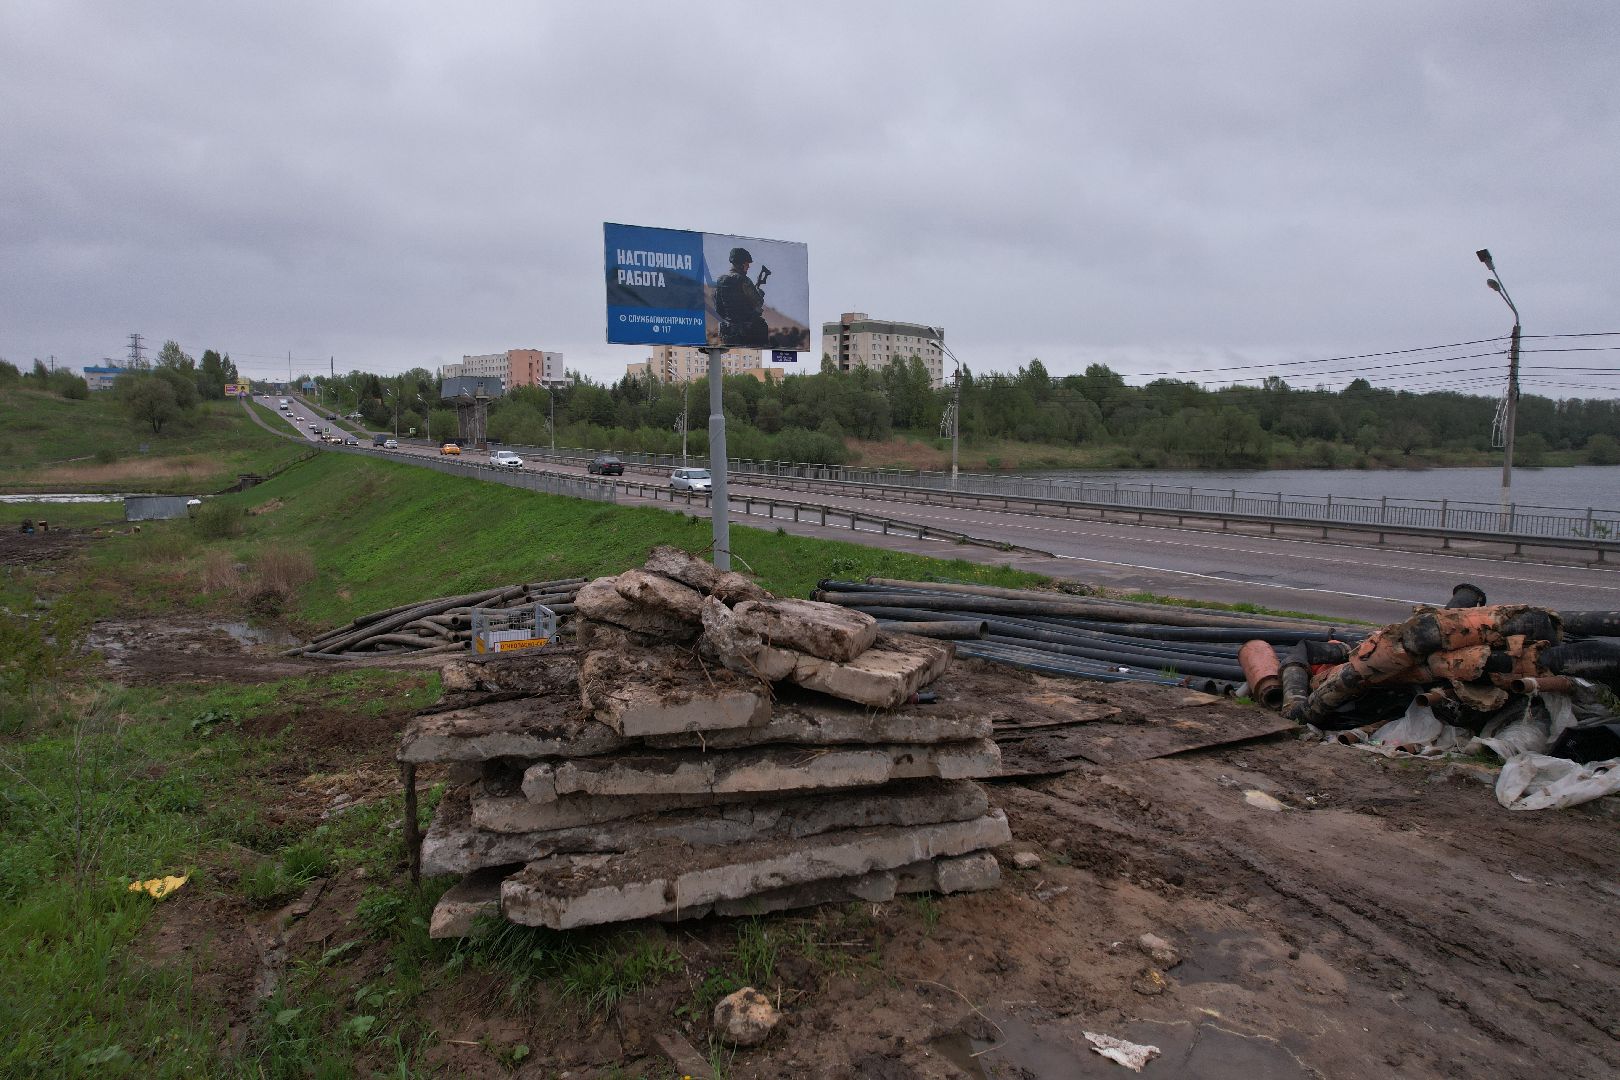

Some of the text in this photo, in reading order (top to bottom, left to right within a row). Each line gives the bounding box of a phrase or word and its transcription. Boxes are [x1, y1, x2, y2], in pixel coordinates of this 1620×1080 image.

[617, 248, 692, 270] НАСТОЯЩАЯ
[617, 269, 666, 287] РАБОТА
[628, 314, 703, 325] СЛУЖБАПОКОНТРАКТУРФ
[662, 325, 671, 333] 117
